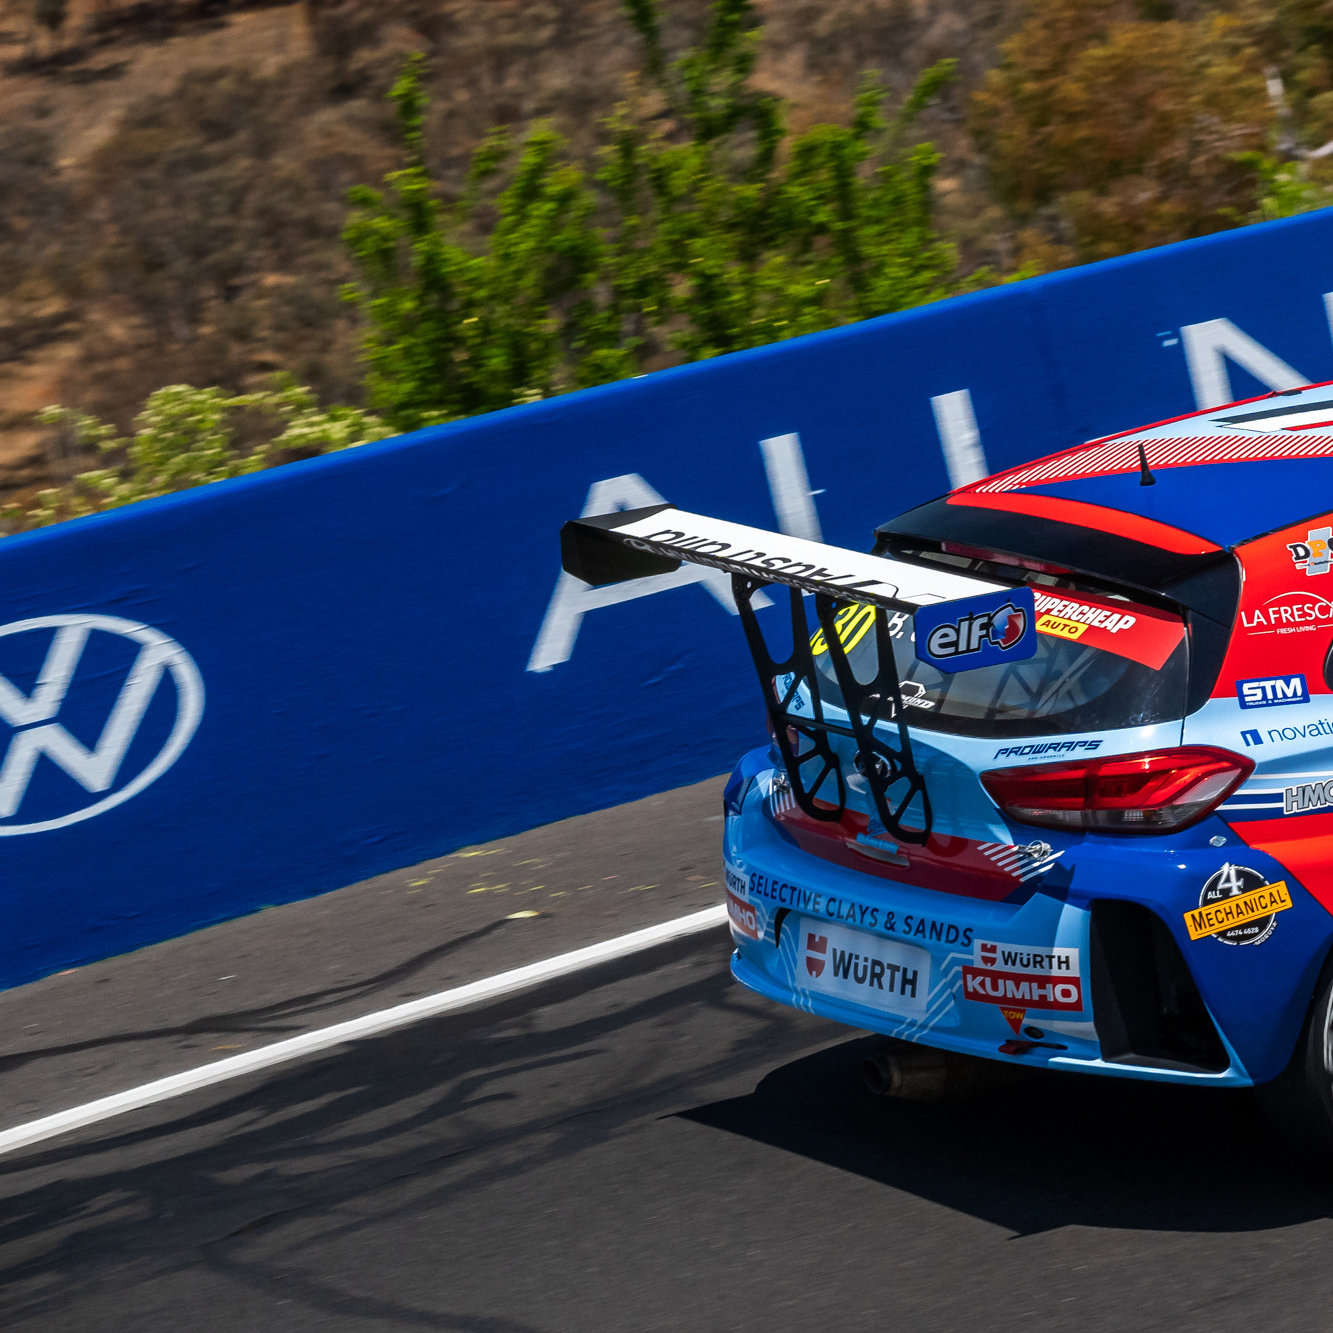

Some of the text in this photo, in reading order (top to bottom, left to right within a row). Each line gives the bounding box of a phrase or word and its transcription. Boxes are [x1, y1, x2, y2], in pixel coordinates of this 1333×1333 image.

[1040, 619, 1079, 634] AUTO
[1241, 609, 1267, 627] LA
[1277, 625, 1316, 634] FRESH LIVING
[928, 616, 988, 656] elf
[1242, 677, 1302, 702] STM
[993, 740, 1103, 760] PROWRAPS
[1217, 862, 1244, 897] 4
[1207, 890, 1222, 900] ALL
[750, 872, 974, 948] SELECTIVE CLAYS & SANDS
[1190, 889, 1287, 933] MECHANICAL
[1001, 950, 1071, 971] WÜRTH
[831, 947, 919, 999] WÜRTH
[966, 974, 1079, 1004] KUMHO
[1003, 1010, 1025, 1020] TOW
